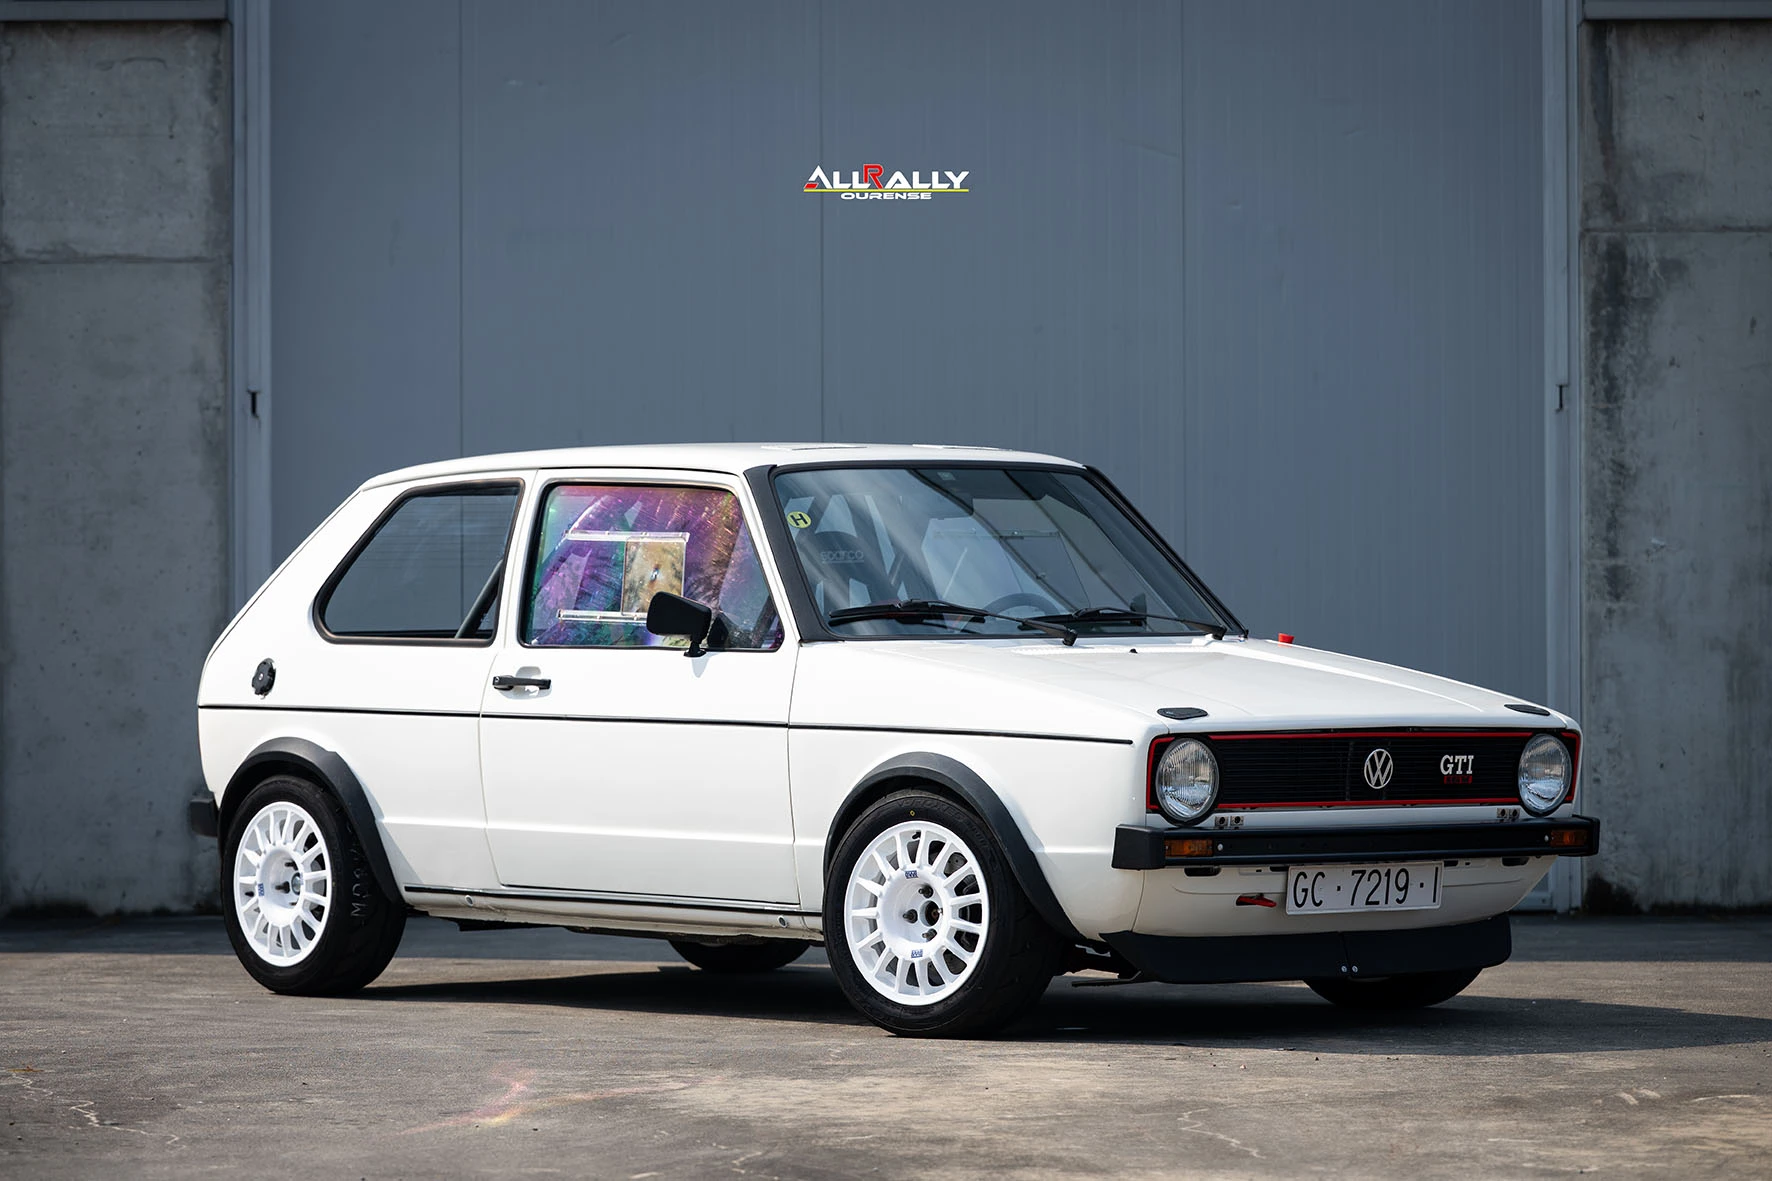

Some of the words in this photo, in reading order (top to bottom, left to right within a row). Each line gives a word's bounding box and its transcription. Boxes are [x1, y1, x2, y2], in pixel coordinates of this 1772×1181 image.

[789, 513, 808, 526] H
[1440, 755, 1474, 775] GTI
[1293, 871, 1326, 908] GC
[1351, 868, 1410, 906] 7219
